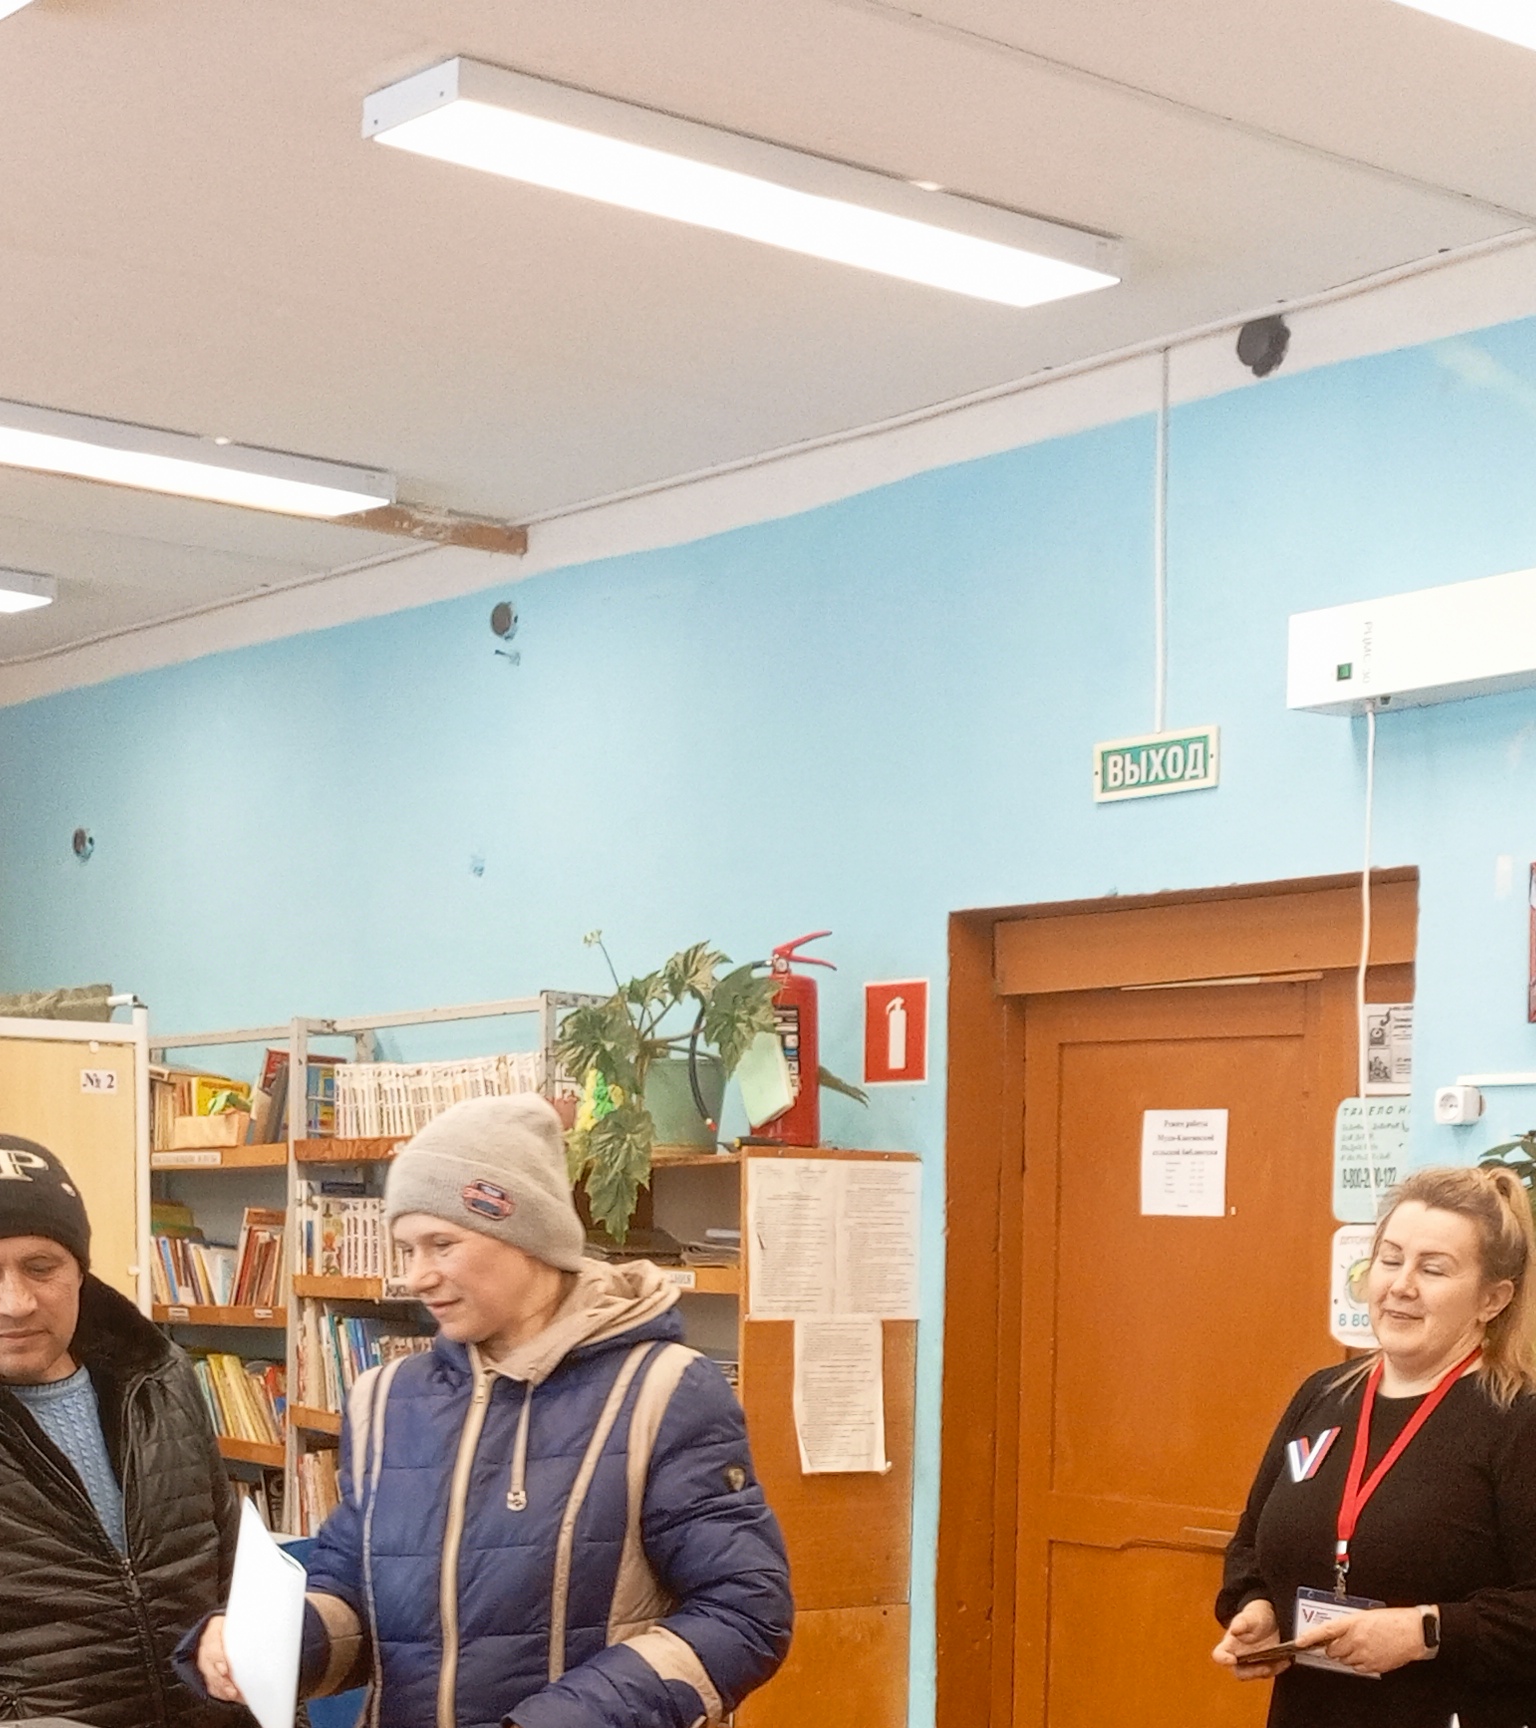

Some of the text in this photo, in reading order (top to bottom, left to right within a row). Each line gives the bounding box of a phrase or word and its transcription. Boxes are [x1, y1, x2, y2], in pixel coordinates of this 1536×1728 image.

[1107, 742, 1205, 788] ВЫХОД
[107, 1074, 114, 1088] 2
[1339, 1313, 1347, 1327] 8
